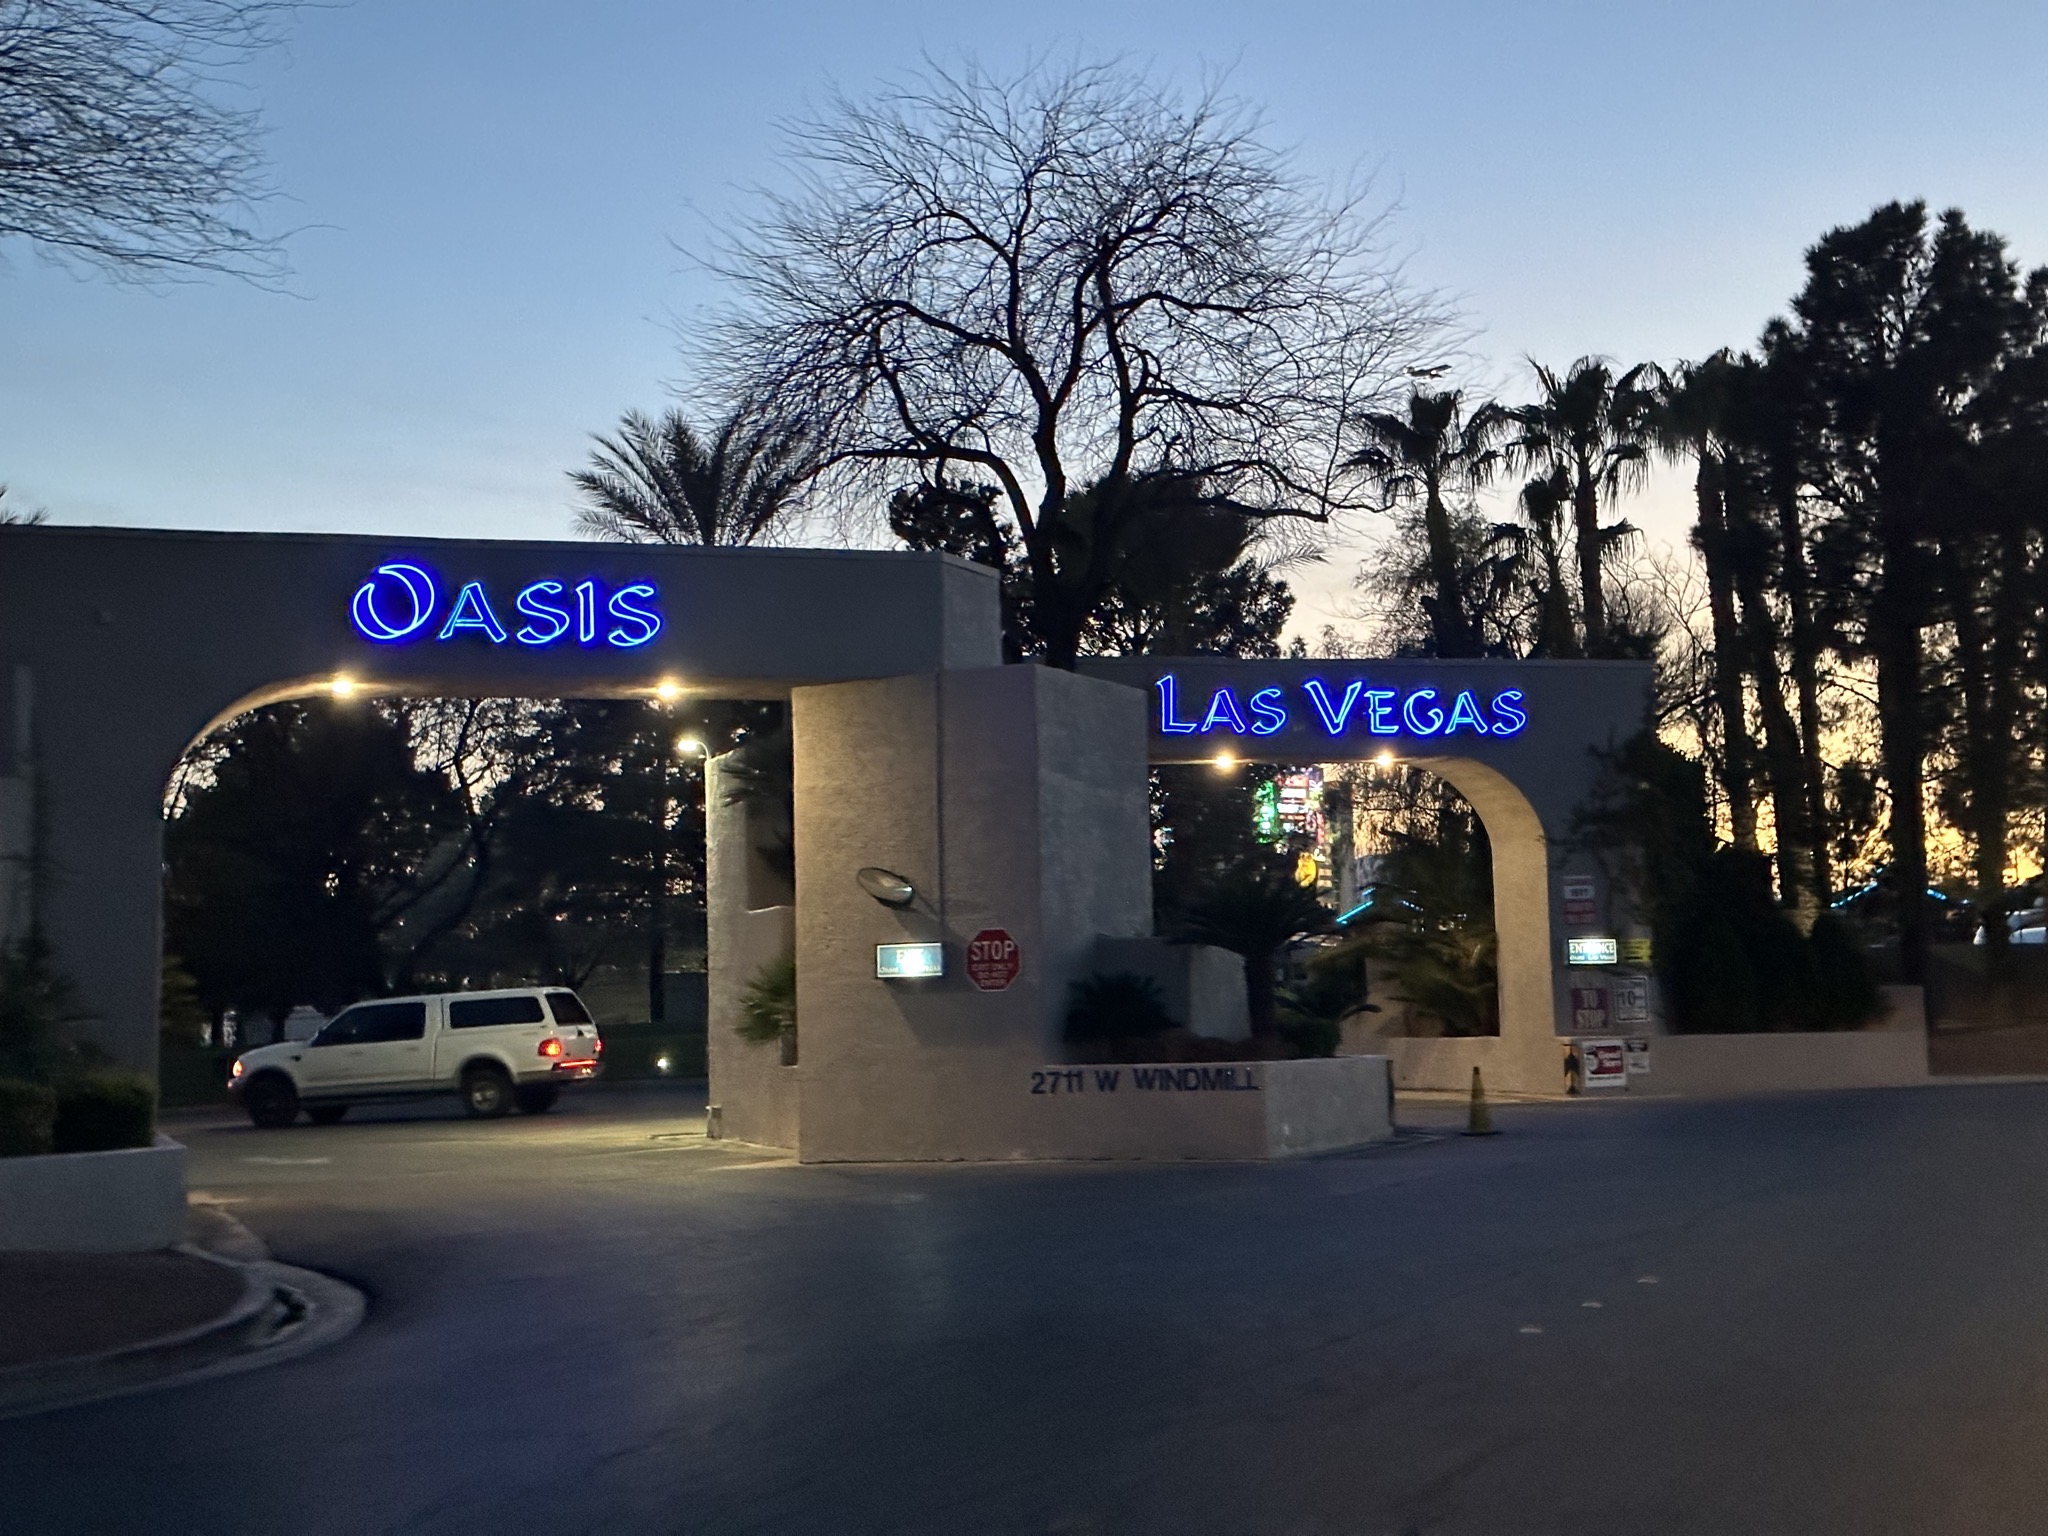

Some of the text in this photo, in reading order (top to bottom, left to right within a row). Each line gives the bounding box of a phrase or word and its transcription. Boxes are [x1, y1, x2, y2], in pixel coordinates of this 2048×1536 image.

[352, 563, 661, 647] OASIS
[1155, 674, 1527, 735] LAS VEGAS
[970, 940, 1015, 961] STOP
[1569, 942, 1614, 954] ENTNCE
[1030, 1066, 1262, 1094] 2711 W WINDMILL
